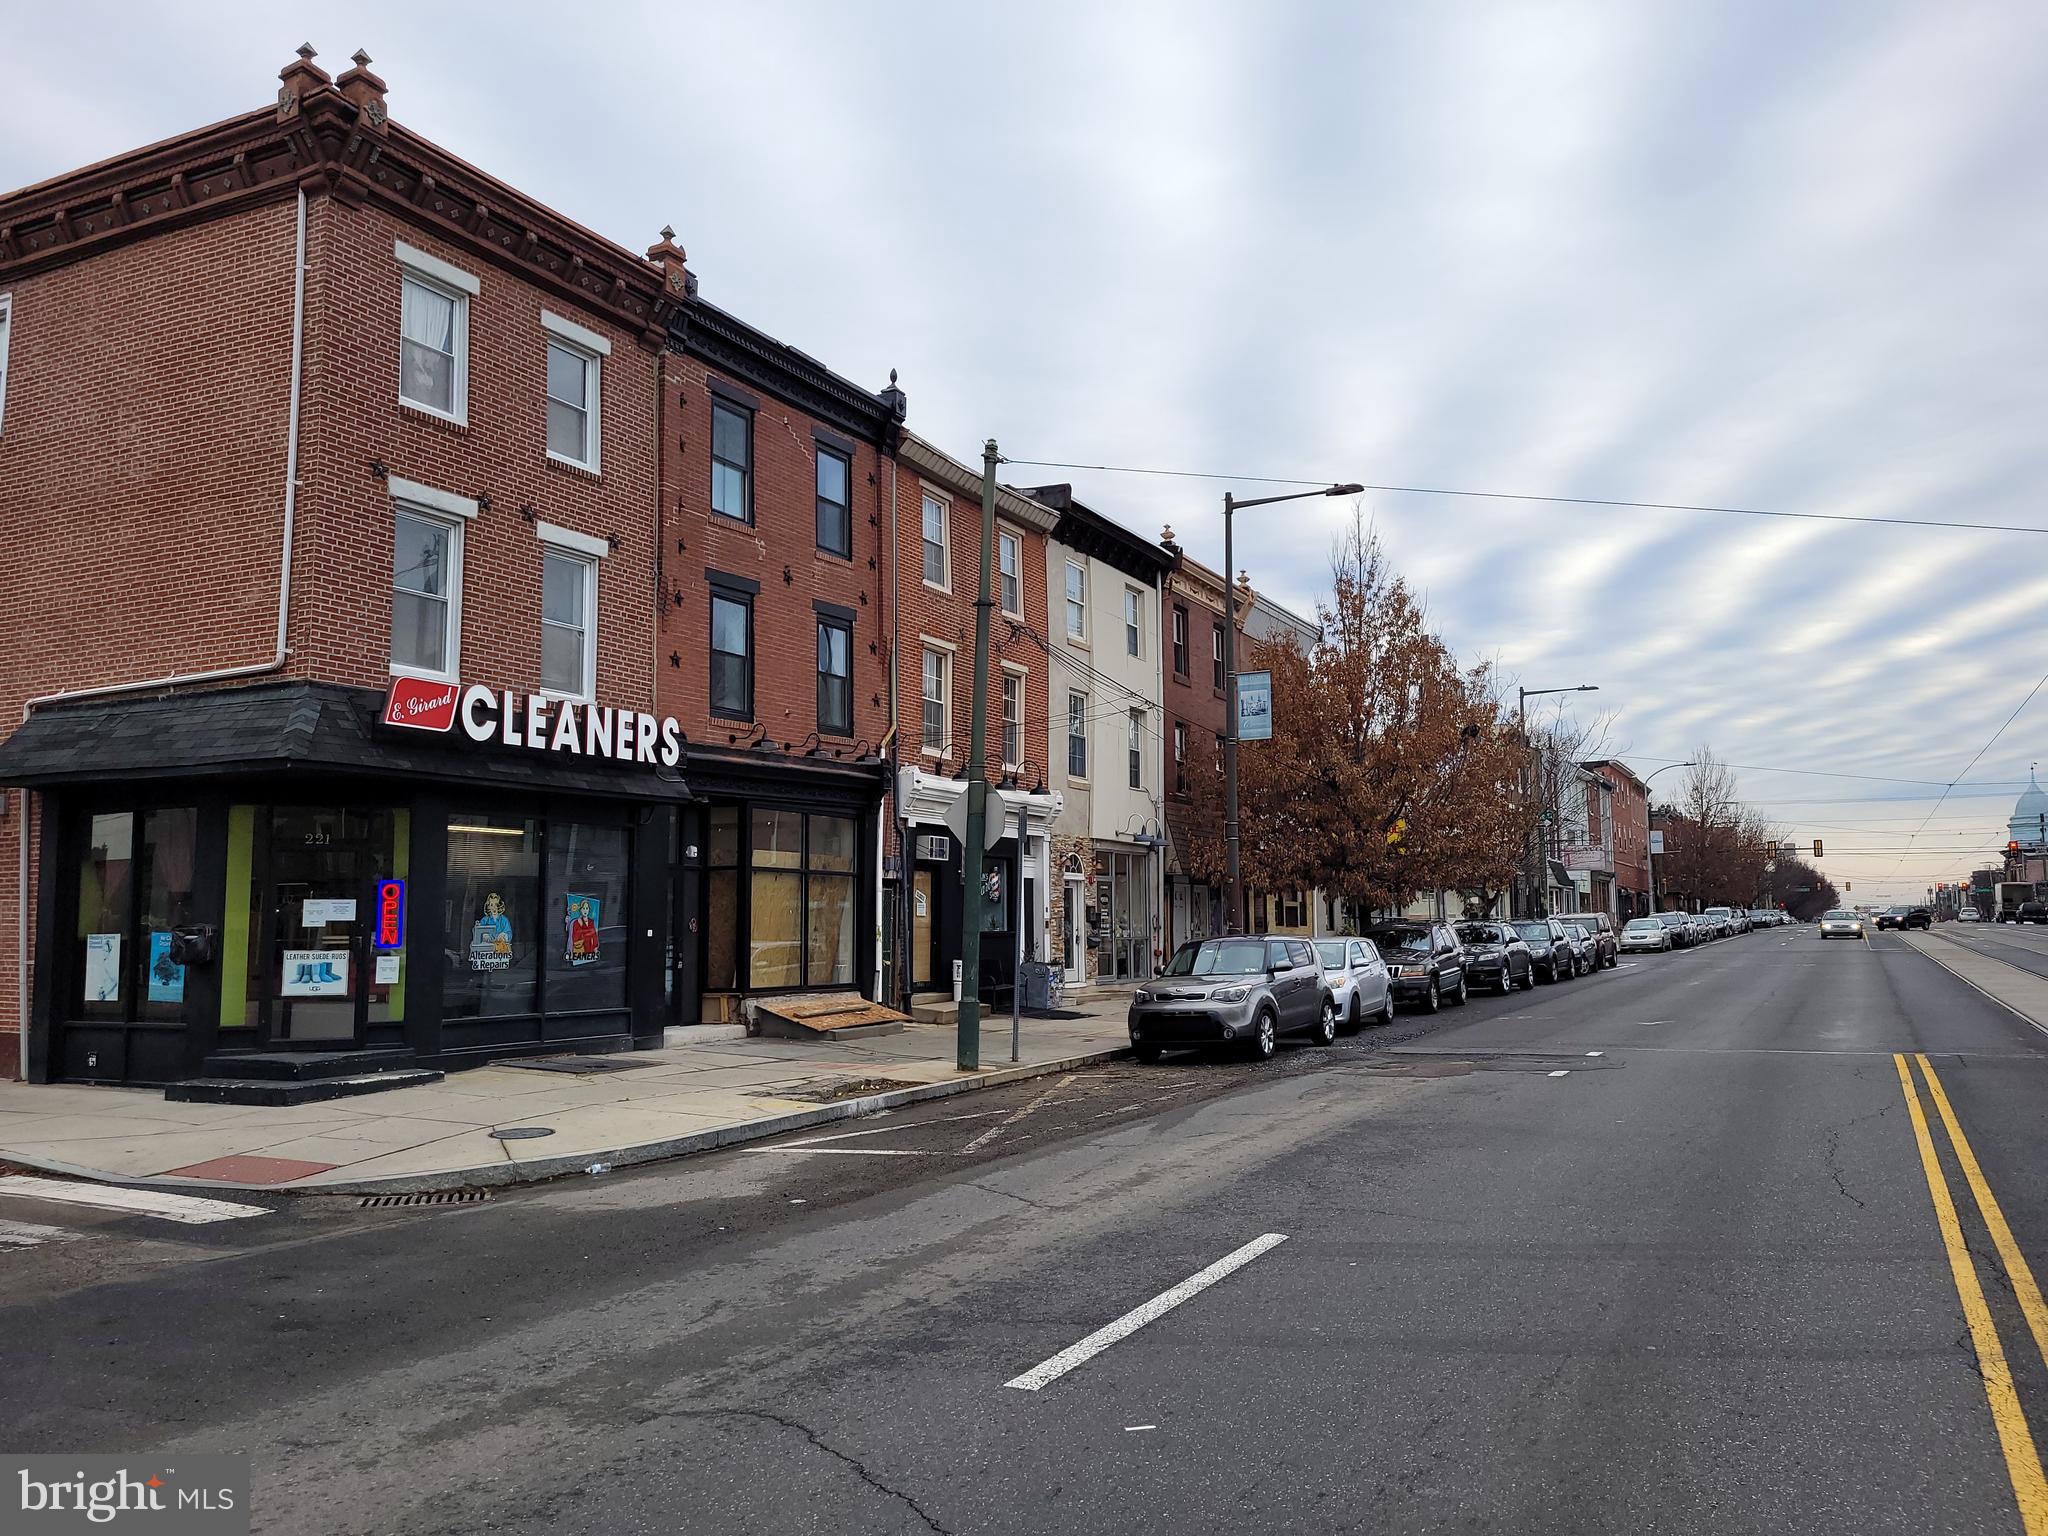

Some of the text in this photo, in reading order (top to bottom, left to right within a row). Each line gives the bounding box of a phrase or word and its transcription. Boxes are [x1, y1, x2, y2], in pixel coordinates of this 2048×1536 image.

[392, 687, 452, 721] E. Girard
[461, 684, 680, 766] CLEANERS
[304, 833, 331, 845] 221
[382, 883, 400, 945] OPEN
[469, 951, 513, 961] Alterations
[563, 951, 600, 961] CLEANERS
[472, 961, 509, 972] & Repairs
